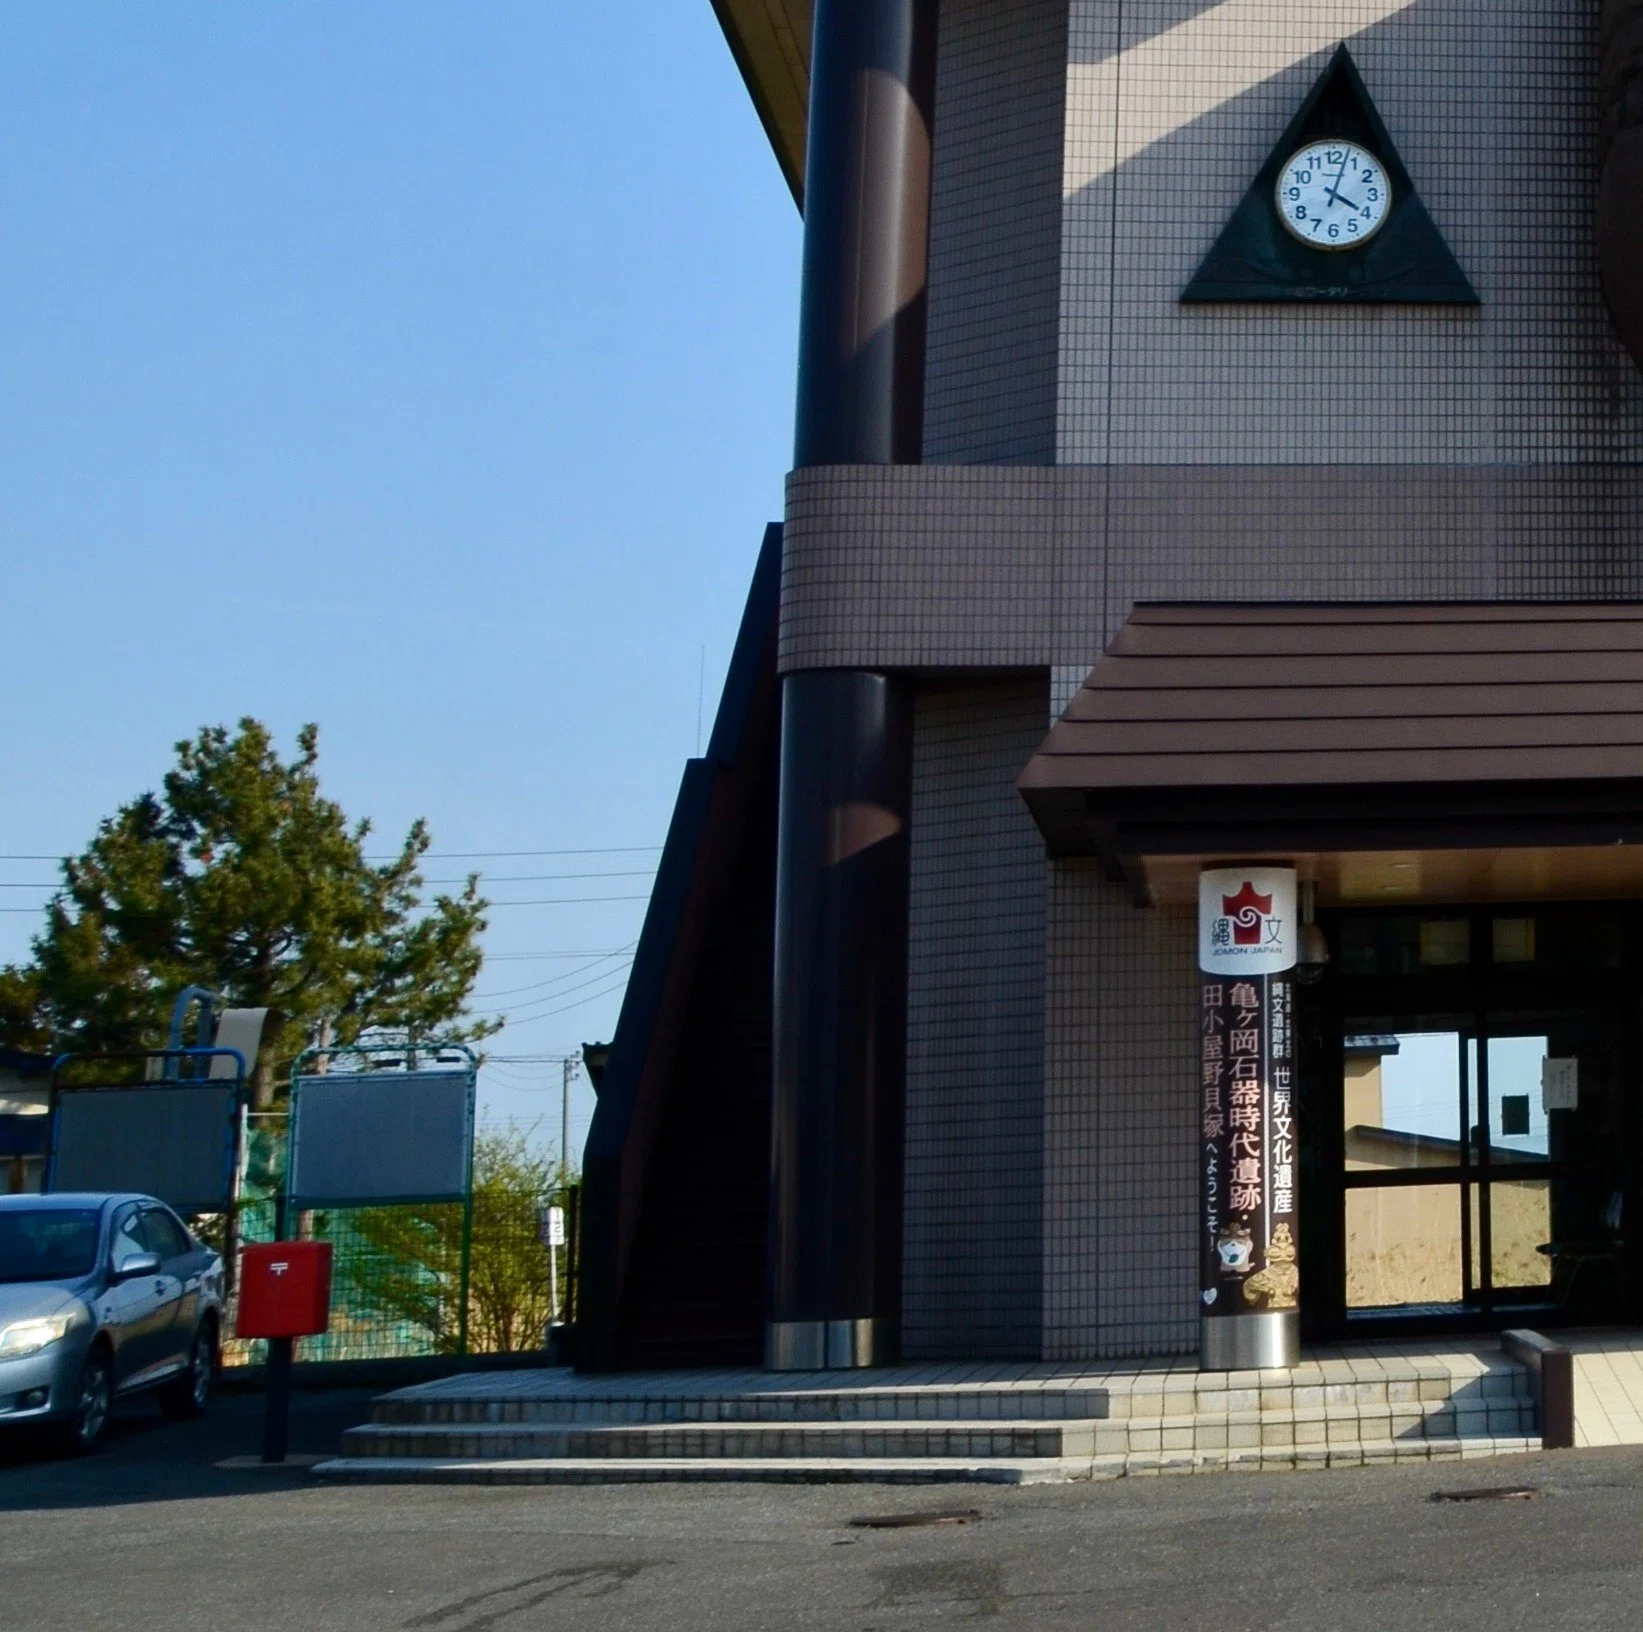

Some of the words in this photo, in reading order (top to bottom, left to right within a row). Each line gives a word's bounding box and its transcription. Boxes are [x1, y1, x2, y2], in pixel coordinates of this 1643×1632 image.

[1307, 156, 1322, 169] 11
[1324, 150, 1343, 165] 12
[1351, 157, 1358, 170] 1
[1295, 171, 1311, 184] 10
[1361, 169, 1373, 183] 2
[1289, 187, 1300, 201] 9
[1367, 188, 1378, 202] 3
[1295, 205, 1307, 219] 8
[1360, 206, 1372, 219] 4
[1310, 219, 1322, 232] 7
[1328, 223, 1339, 238] 6
[1347, 218, 1358, 233] 5
[1213, 948, 1248, 957] JOMON
[1251, 946, 1283, 954] JAPAN
[1272, 1066, 1293, 1214] 世界文化遺産
